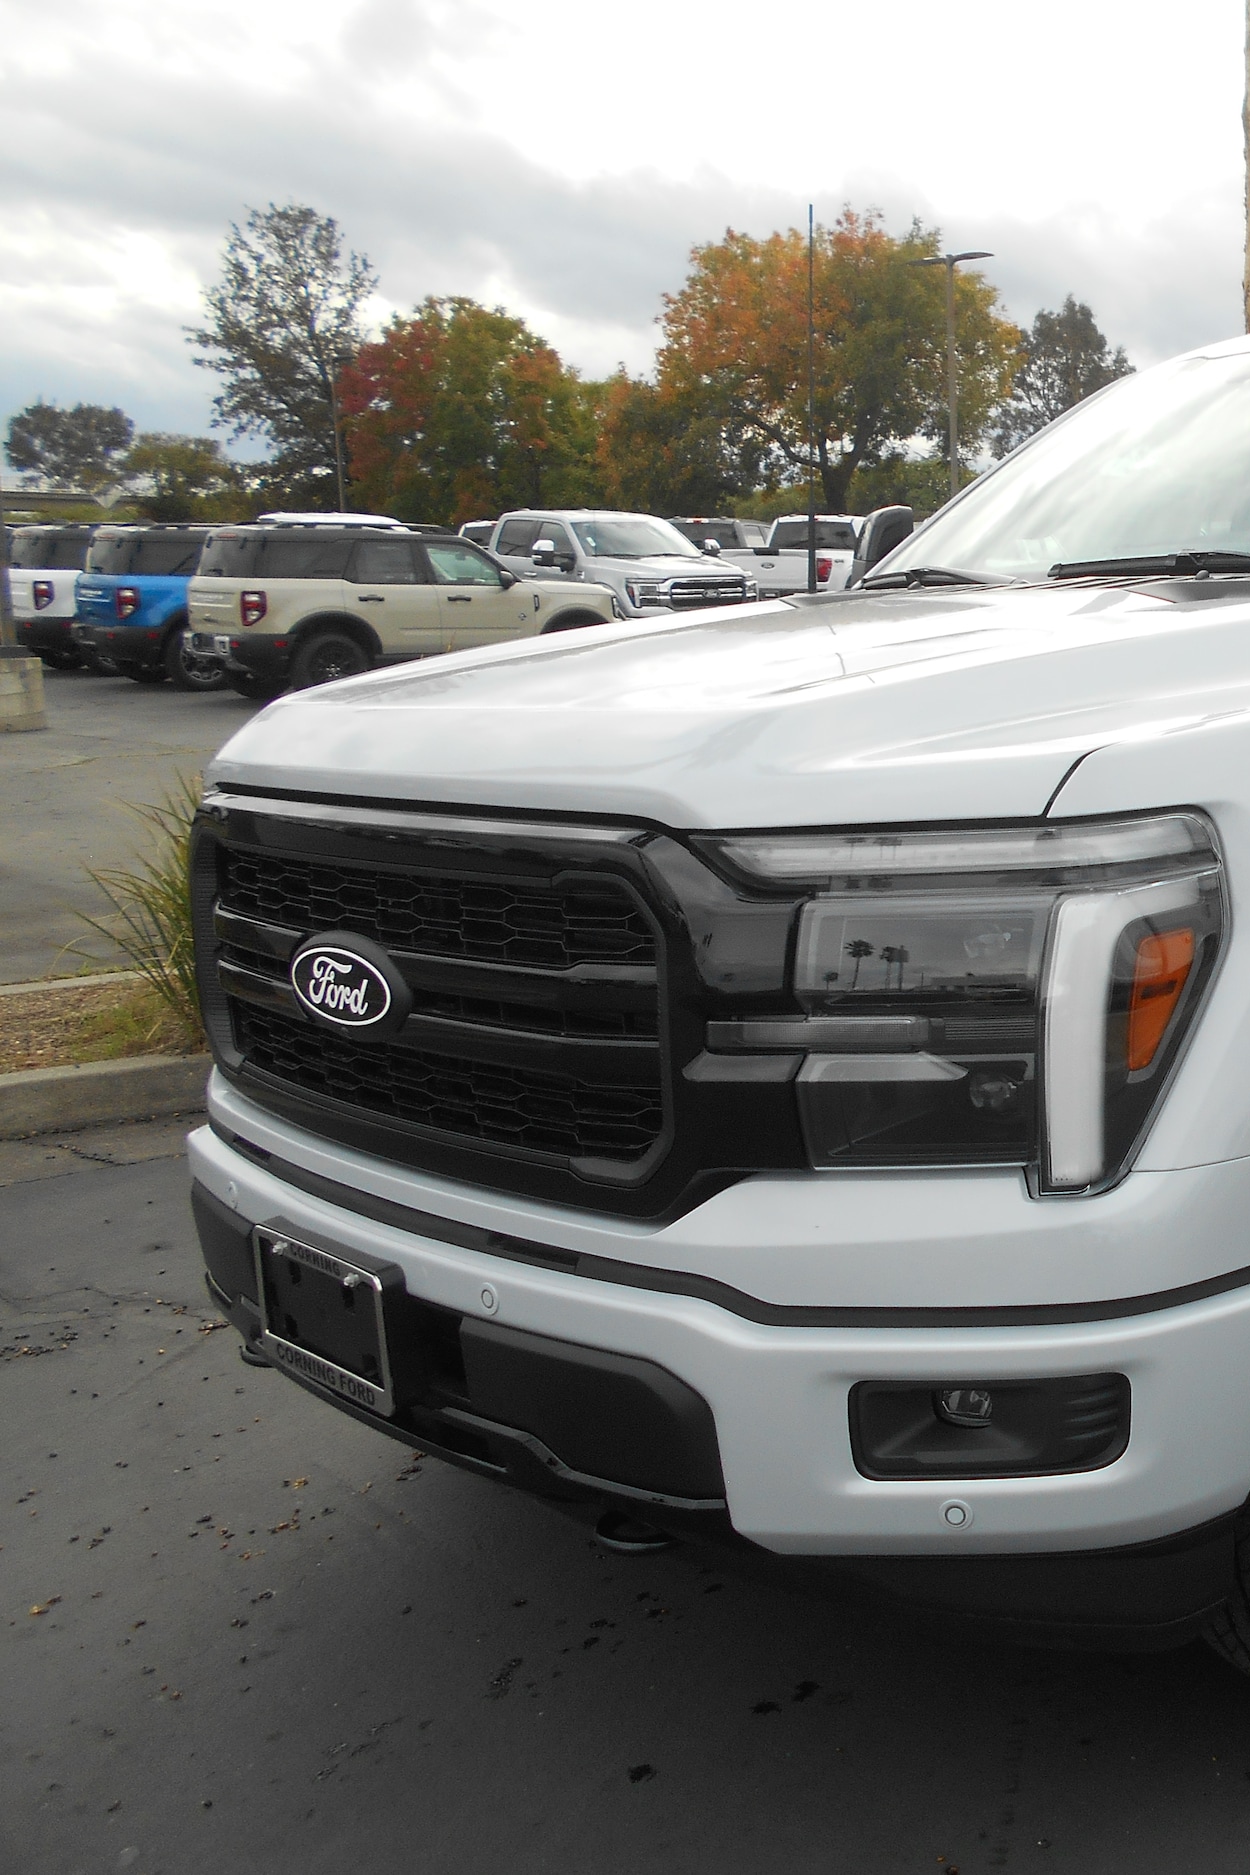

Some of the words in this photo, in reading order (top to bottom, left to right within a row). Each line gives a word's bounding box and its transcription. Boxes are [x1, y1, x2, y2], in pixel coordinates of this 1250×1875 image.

[308, 955, 369, 1016] Ford
[276, 1342, 336, 1386] CORNING
[340, 1373, 376, 1407] FORD
